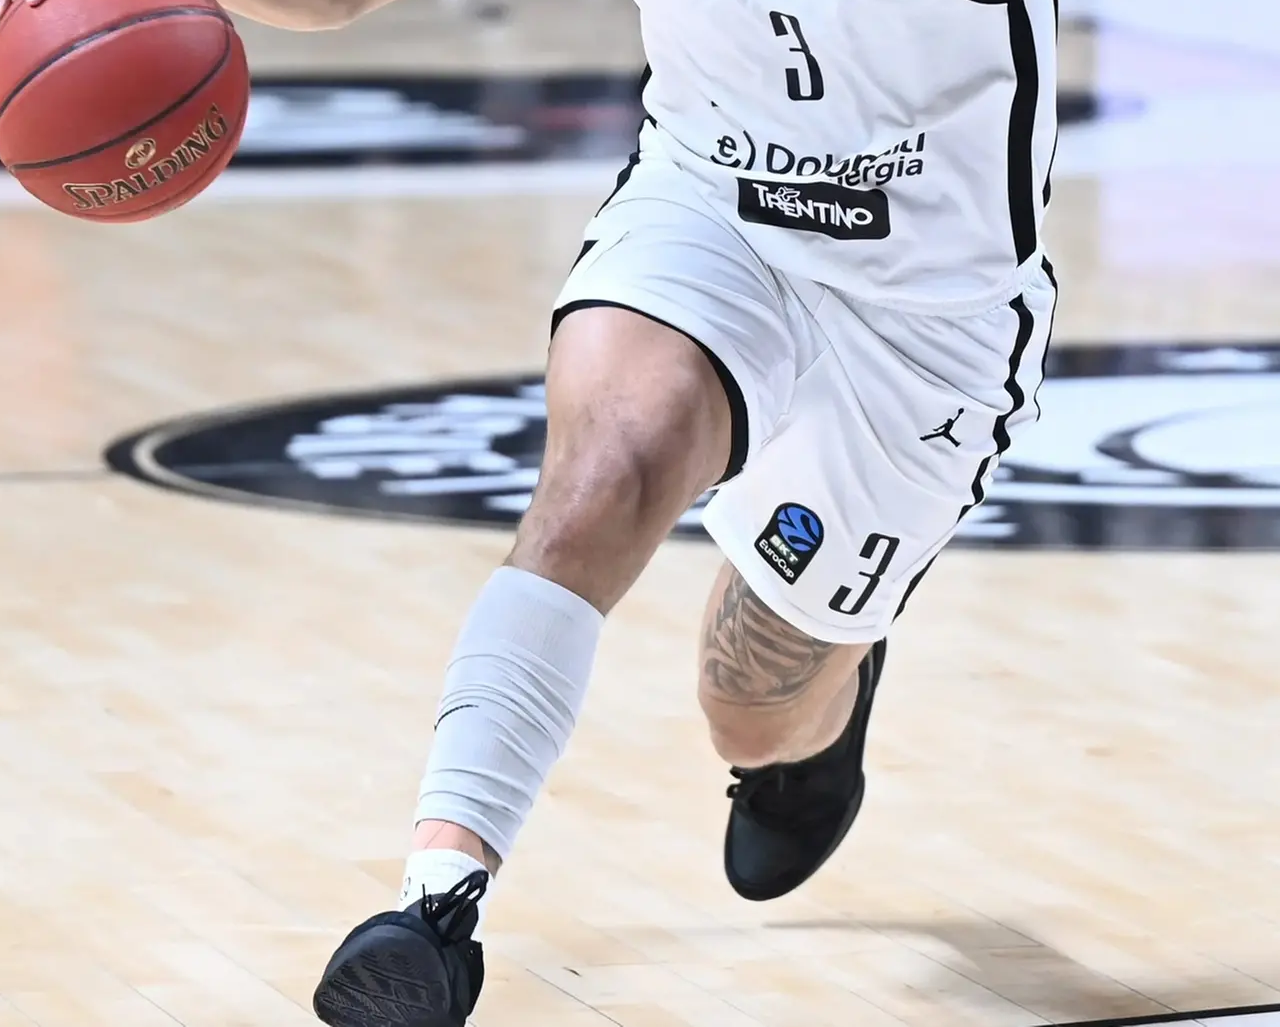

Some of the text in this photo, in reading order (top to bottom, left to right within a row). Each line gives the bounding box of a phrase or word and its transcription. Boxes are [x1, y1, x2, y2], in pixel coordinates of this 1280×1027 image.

[769, 10, 825, 101] 3
[62, 103, 229, 210] SPALDING
[752, 182, 874, 230] TRENTINO
[758, 538, 795, 580] EuroCup
[828, 532, 901, 616] 3
